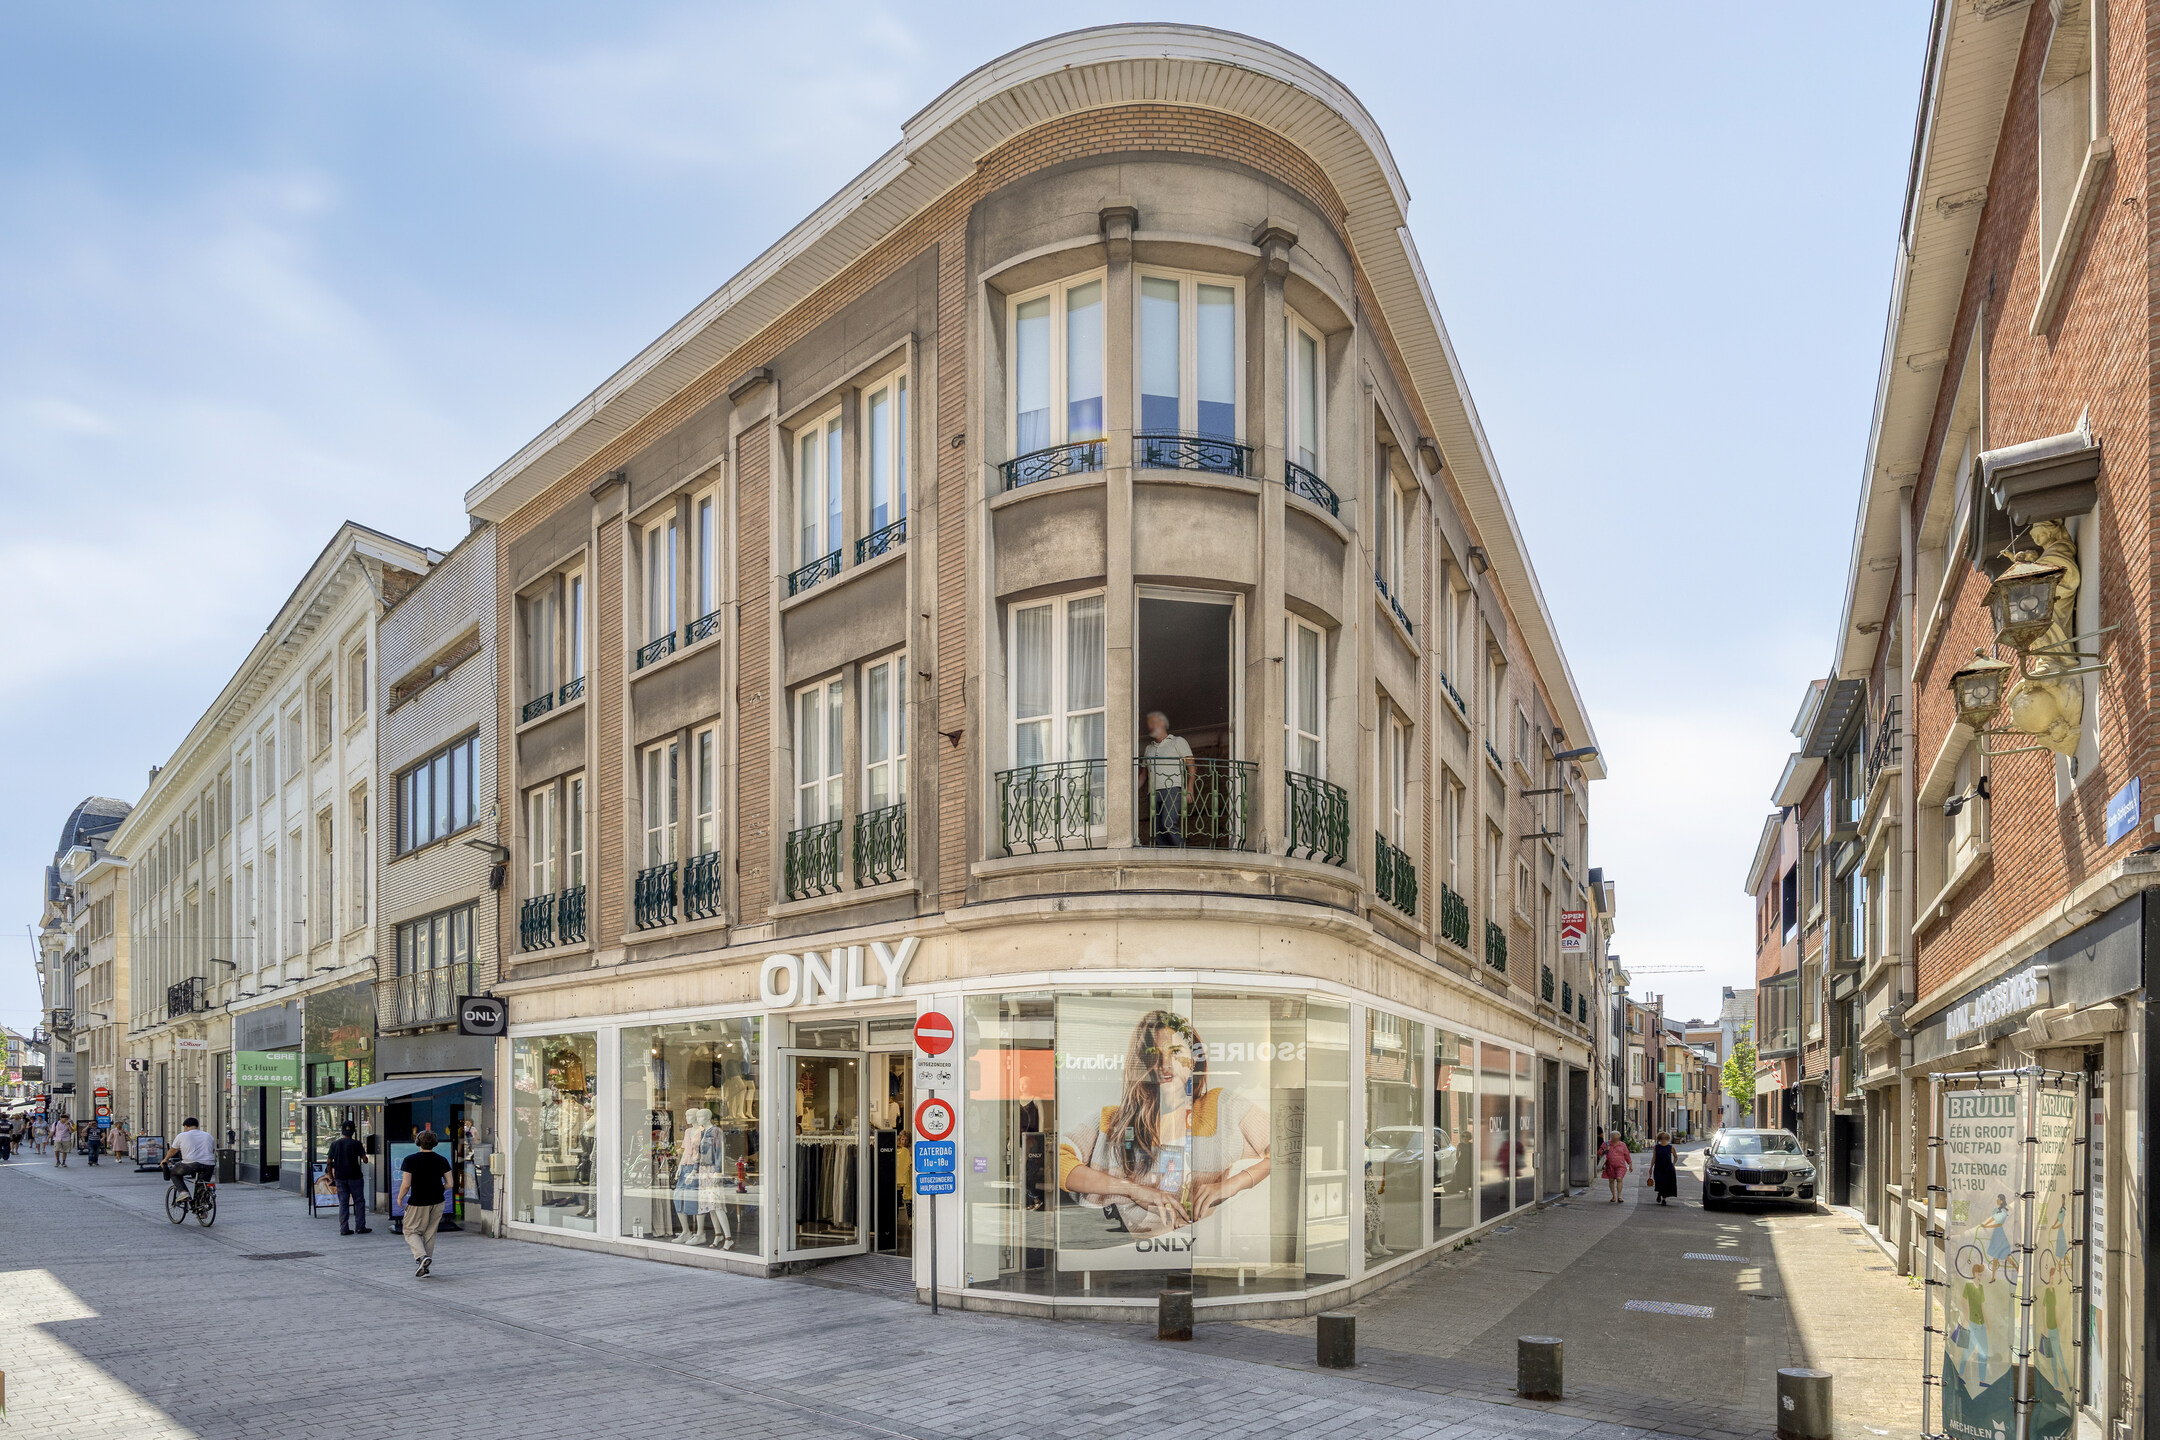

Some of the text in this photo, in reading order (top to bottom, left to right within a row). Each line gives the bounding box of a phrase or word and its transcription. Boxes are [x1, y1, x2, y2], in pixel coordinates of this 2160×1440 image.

[760, 936, 921, 1008] ONLY
[464, 1010, 502, 1022] ONLY
[241, 1063, 278, 1072] Te Huur
[1950, 1096, 2014, 1118] BRUUL
[2042, 1095, 2071, 1117] BRUUL
[1489, 1116, 1503, 1133] ONLY
[1949, 1124, 2015, 1139] ÉÉN GROOT
[2041, 1122, 2053, 1138] ÉÉN
[919, 1147, 953, 1156] ZATERDAG
[1949, 1142, 2002, 1155] VOETPAD
[923, 1158, 949, 1167] 11u-18u
[1951, 1162, 2008, 1177] ZATERDAG
[2040, 1163, 2067, 1177] ZATERDAG
[919, 1176, 953, 1184] UITGEZONDERD
[1951, 1178, 1986, 1191] 11-18U
[919, 1183, 953, 1192] HULPDIENSTEN
[1135, 1237, 1197, 1252] ONLY
[1949, 1419, 1992, 1439] MECHELEN
